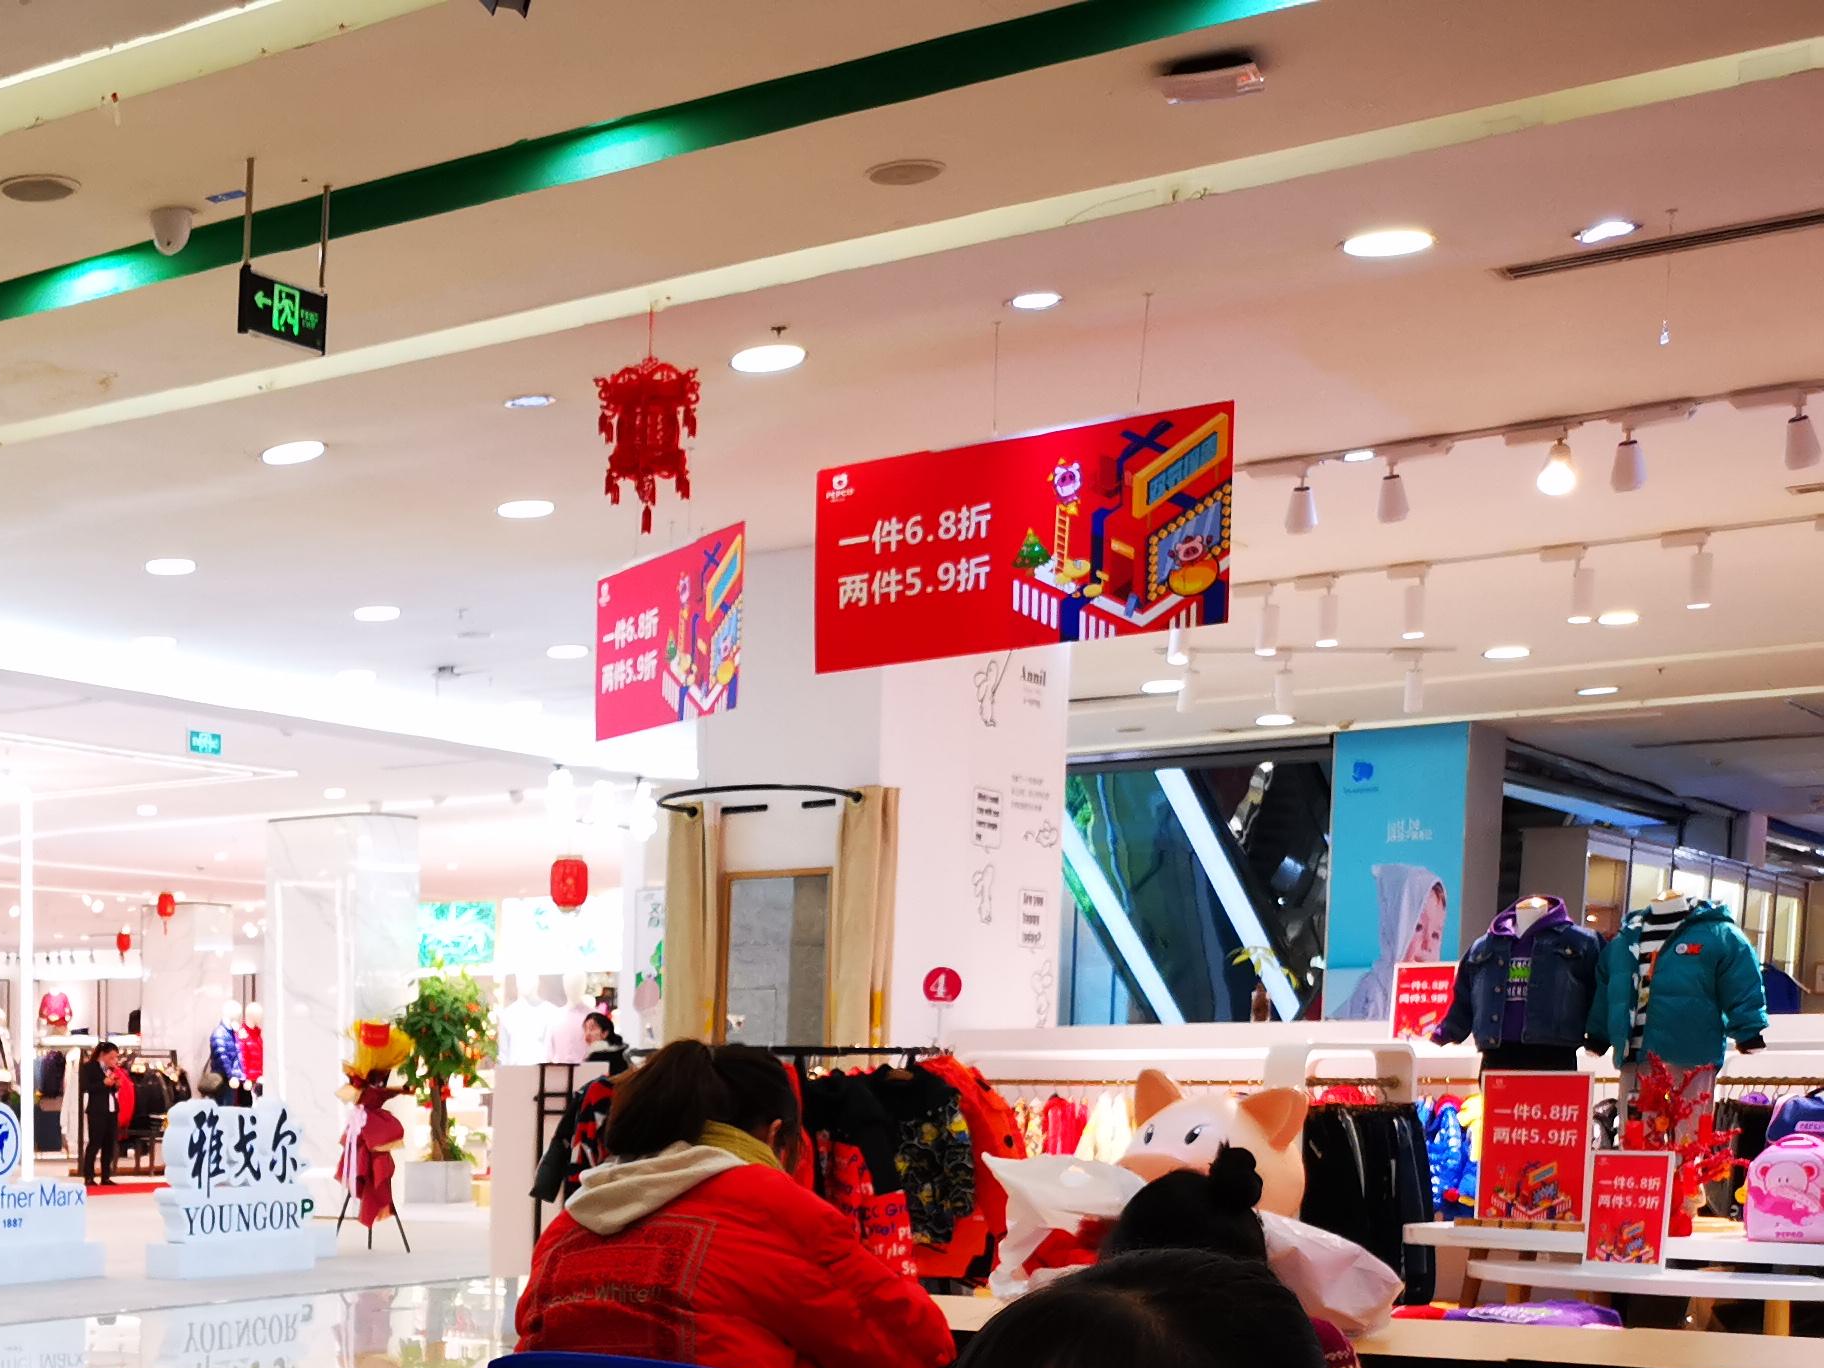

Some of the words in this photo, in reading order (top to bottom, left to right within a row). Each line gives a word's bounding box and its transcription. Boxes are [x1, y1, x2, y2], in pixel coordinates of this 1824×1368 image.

[838, 502, 991, 554] 一件6.8折
[838, 554, 991, 610] 两件5.9折
[602, 606, 659, 650] 一件6.8折
[601, 649, 658, 694] 两件5.9折
[1020, 665, 1047, 687] Annil
[929, 972, 947, 998] 4
[1493, 1103, 1580, 1122] 一件6.8折
[1492, 1126, 1578, 1146] 两件5.9折
[187, 1107, 303, 1199] 雅戈尔
[1599, 1175, 1661, 1191] 一件6.8折
[39, 1184, 85, 1209] Marx
[1597, 1194, 1660, 1209] 两件5.9折
[2, 1217, 24, 1229] 1887
[183, 1200, 300, 1237] YOUNGOR
